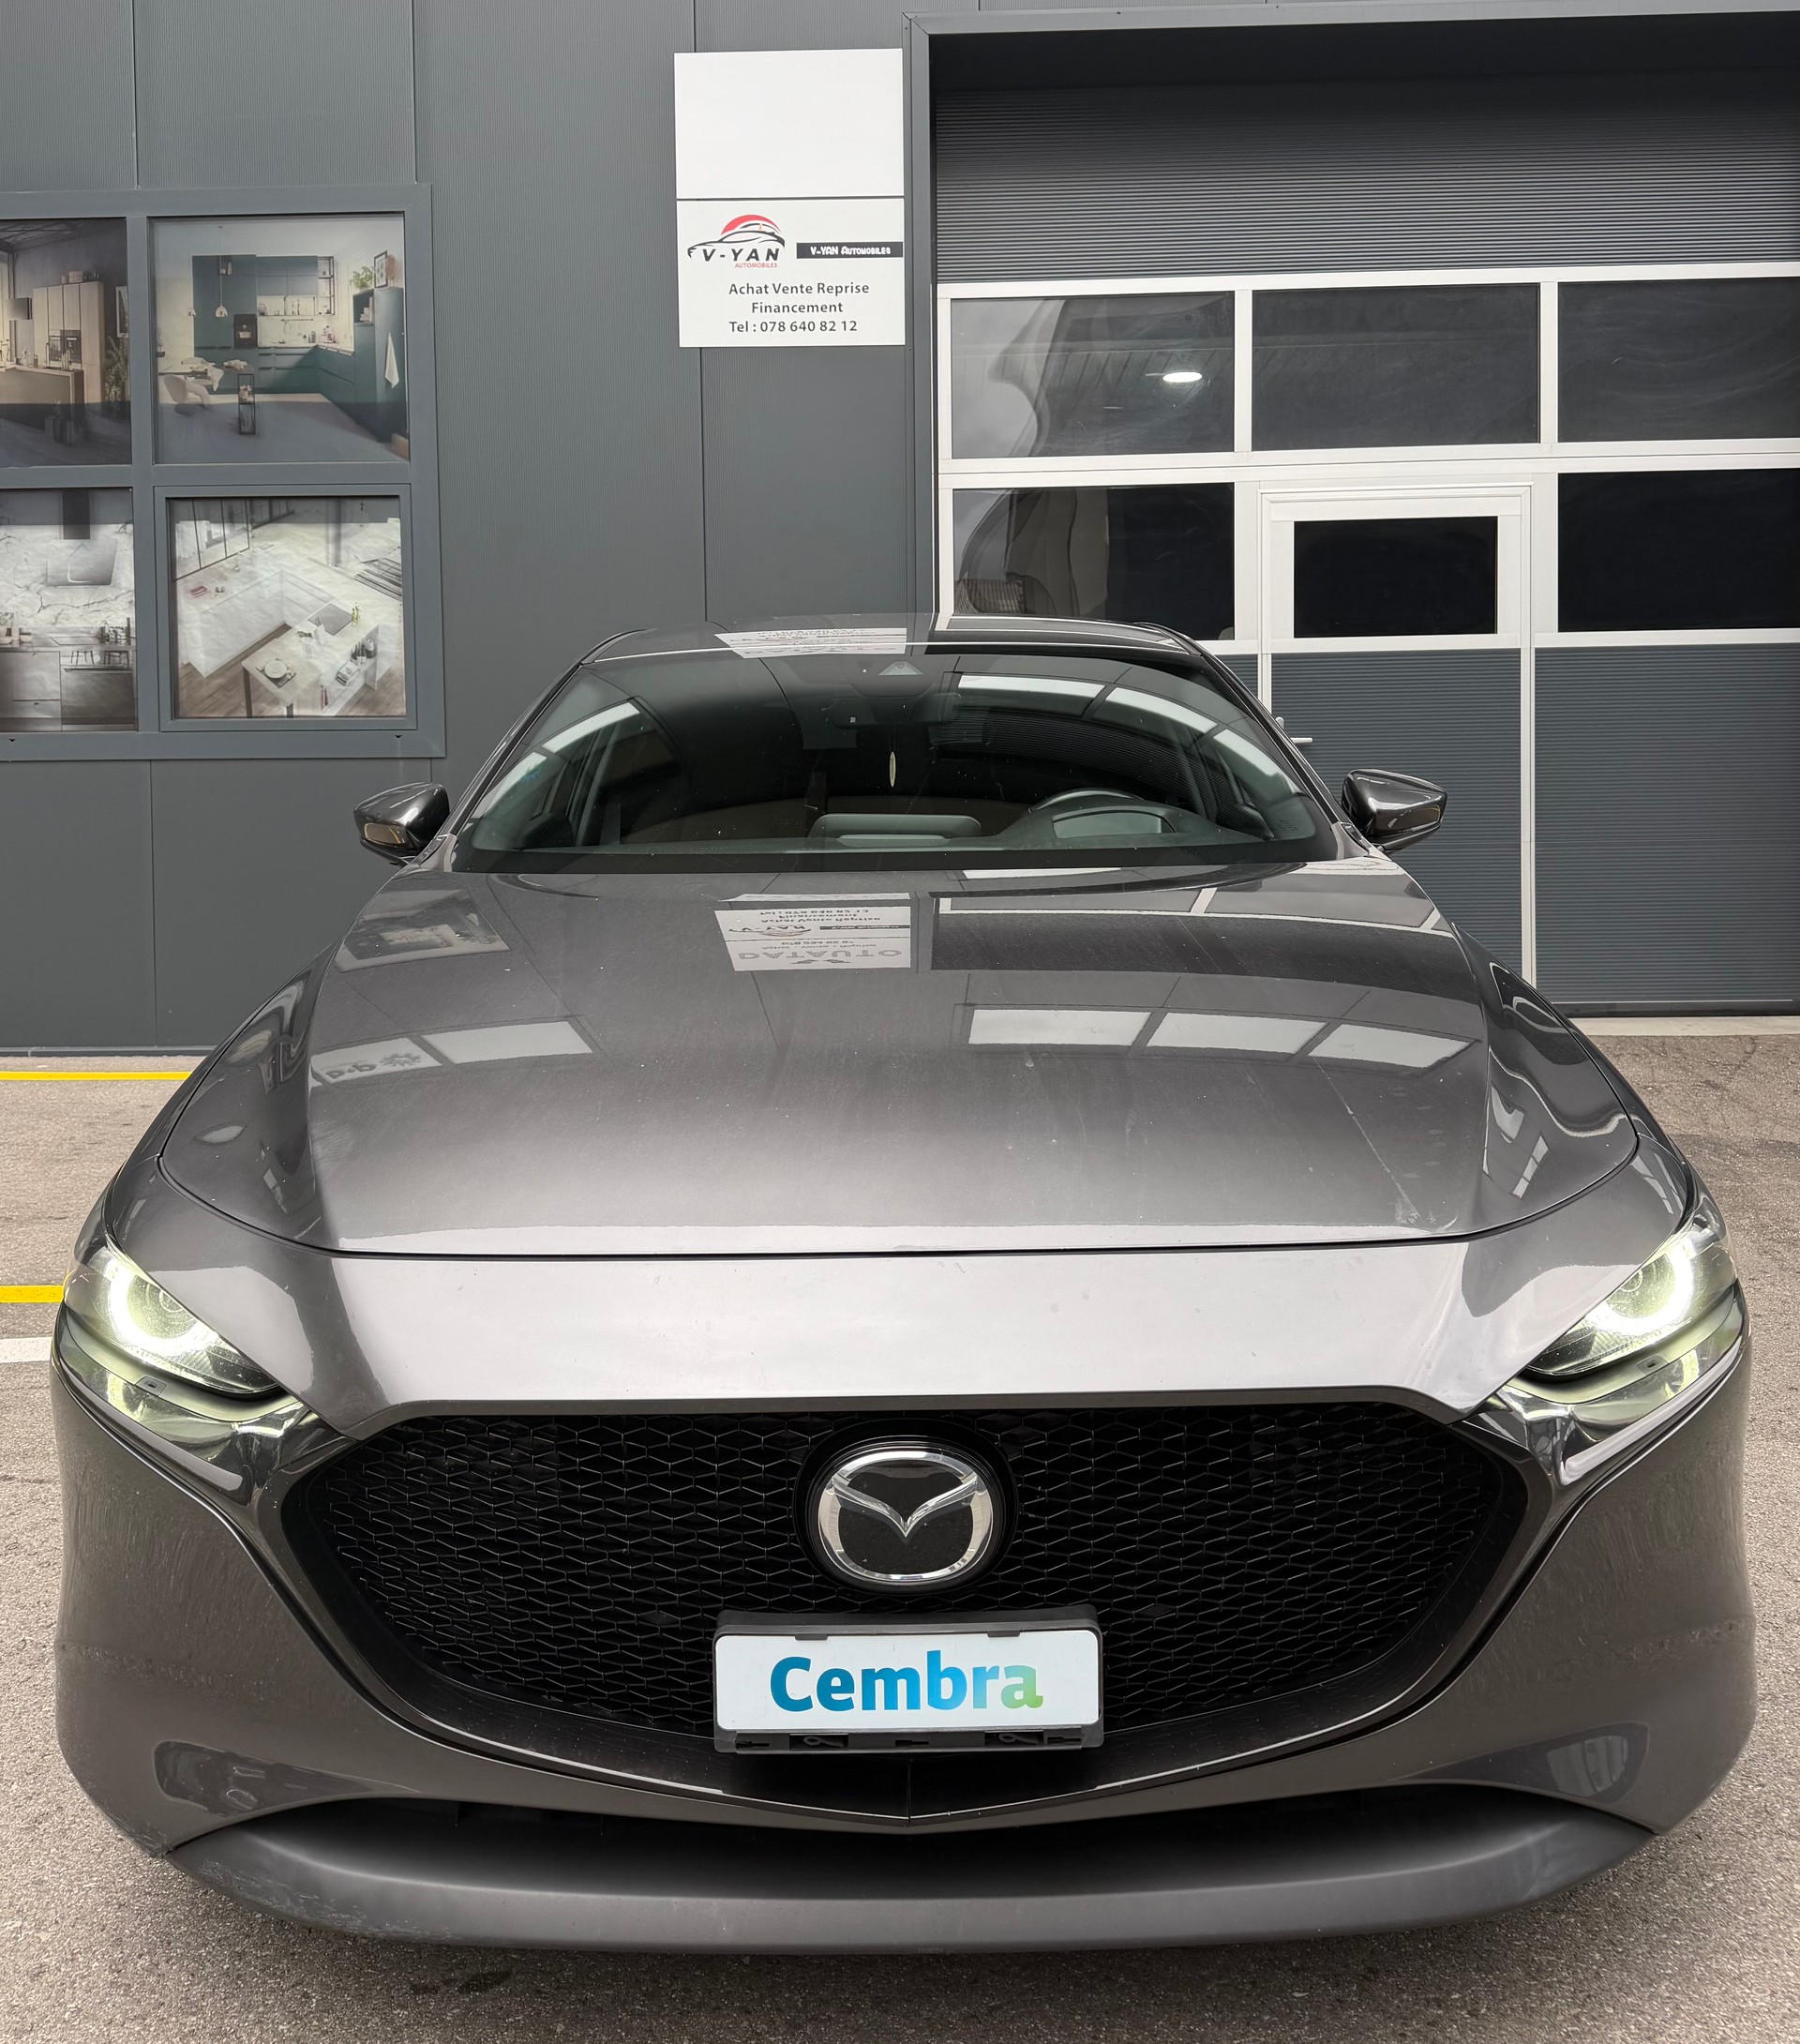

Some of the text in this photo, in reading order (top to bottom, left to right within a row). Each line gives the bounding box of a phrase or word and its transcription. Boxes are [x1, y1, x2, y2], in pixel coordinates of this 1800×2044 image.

[703, 248, 779, 262] V-YAN
[810, 246, 838, 255] V-YAN
[729, 282, 869, 296] Achat Vente Reprise
[752, 302, 843, 313] Financement
[760, 322, 786, 332] 078
[790, 322, 815, 332] 640
[820, 321, 835, 331] 82
[842, 321, 857, 331] 12
[771, 1650, 1042, 1712] Cembra
